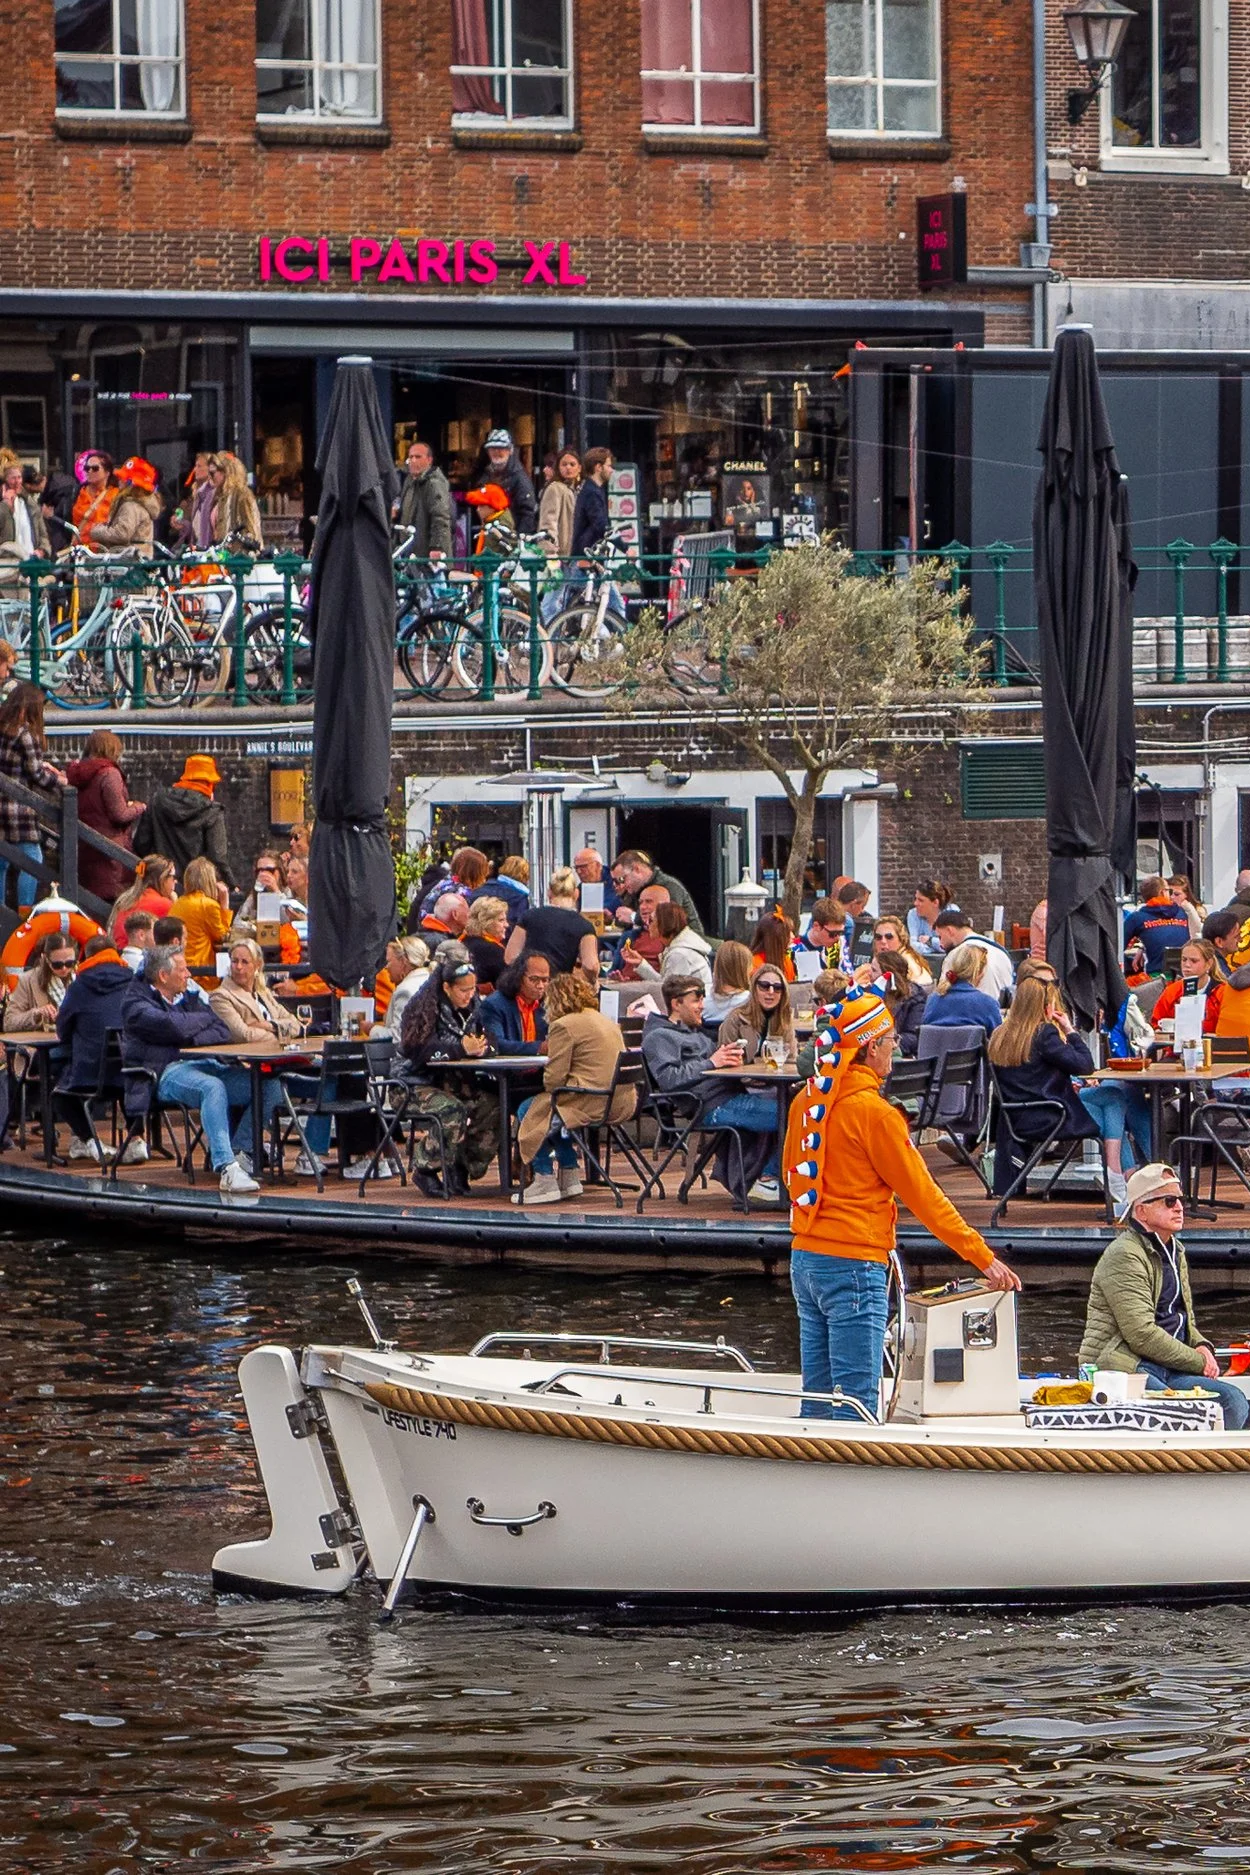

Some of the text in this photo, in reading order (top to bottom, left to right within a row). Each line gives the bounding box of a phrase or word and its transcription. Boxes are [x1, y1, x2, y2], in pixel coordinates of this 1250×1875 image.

[930, 210, 942, 228] ICI
[924, 231, 947, 250] PARIS
[259, 236, 586, 285] ICI PARIS XL
[931, 253, 942, 271] XL
[723, 460, 767, 472] CHANEL
[277, 741, 314, 753] BOULEVAR
[381, 1407, 457, 1441] LIFESTYLE 740
